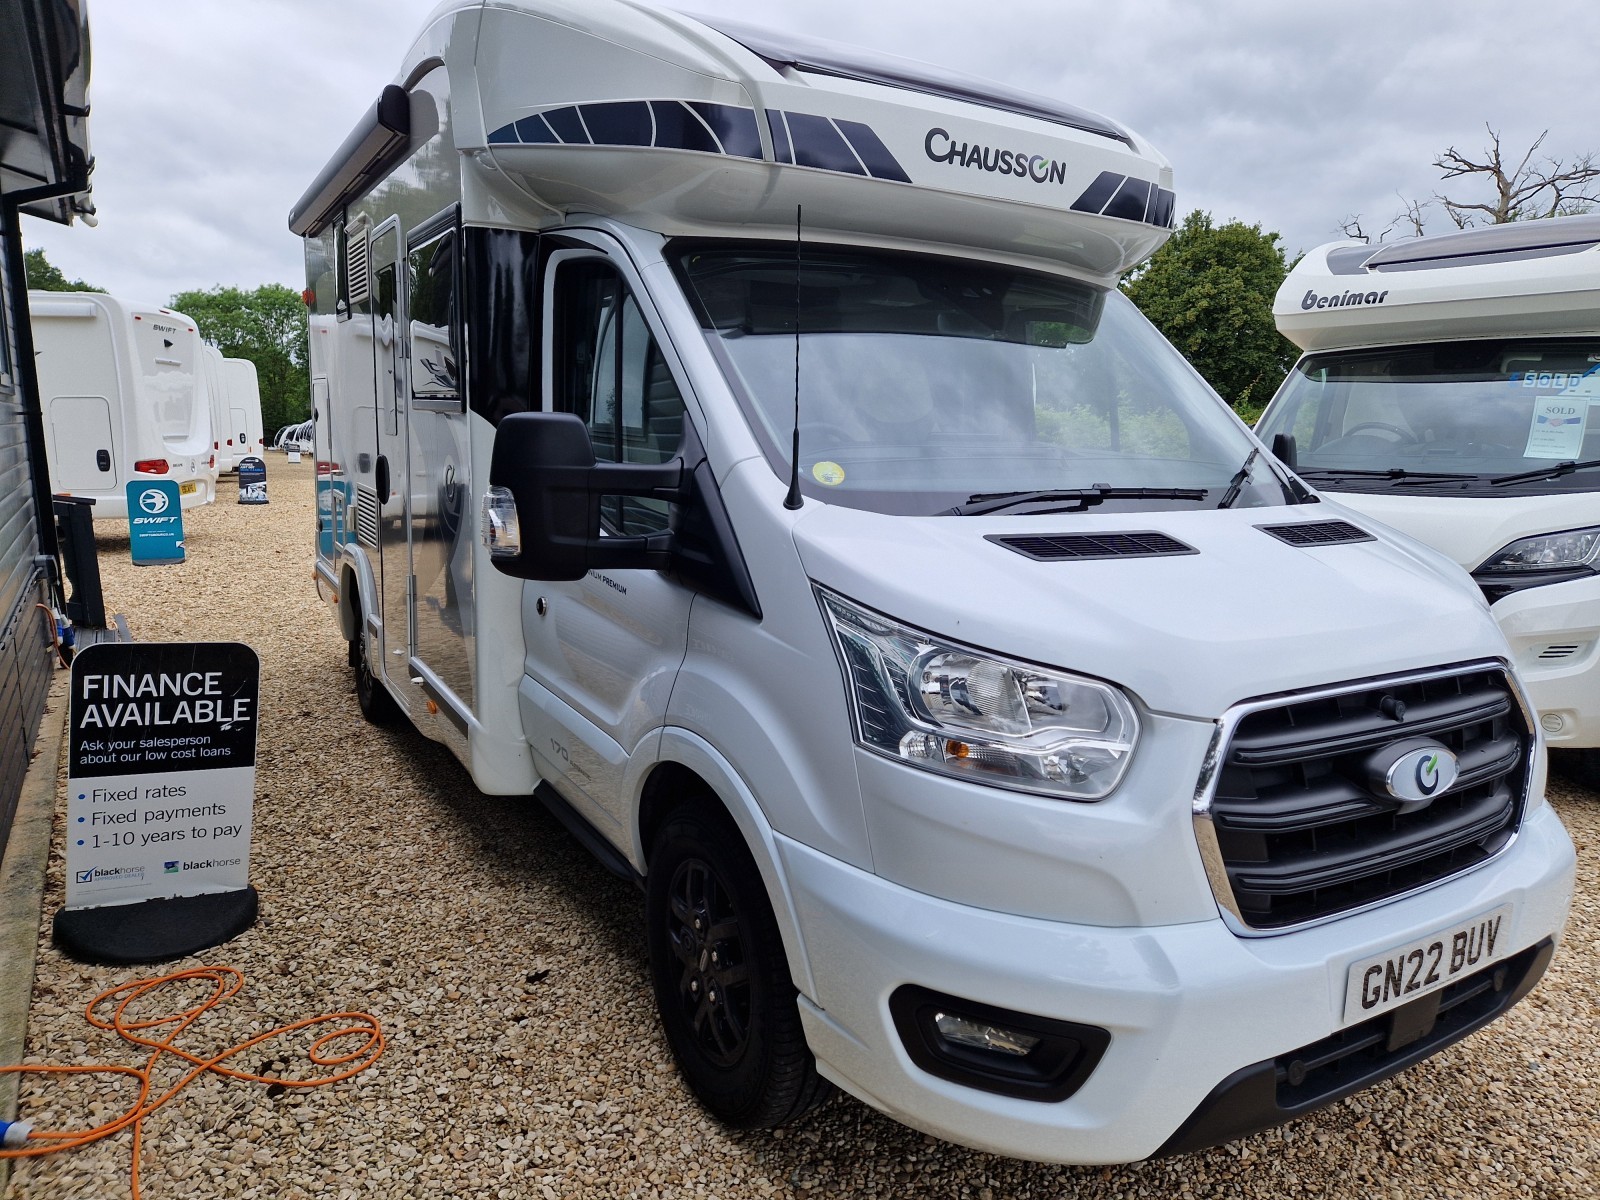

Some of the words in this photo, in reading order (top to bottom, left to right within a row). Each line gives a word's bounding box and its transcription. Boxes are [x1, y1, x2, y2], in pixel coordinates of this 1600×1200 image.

[924, 127, 1067, 185] CHAUSSON
[1301, 289, 1388, 310] benimar
[153, 324, 176, 334] SWIFT
[1525, 375, 1580, 387] SOLD
[1545, 406, 1576, 415] SOLD
[132, 516, 179, 524] SWIFT
[602, 575, 627, 596] PREMIUM
[83, 671, 223, 700] FINANCE
[79, 698, 251, 729] AVAILABLE
[80, 740, 104, 751] Ask
[108, 740, 136, 751] your
[139, 736, 211, 748] salesperson
[550, 737, 569, 762] 170
[80, 752, 117, 764] about
[120, 752, 141, 761] our
[145, 750, 168, 760] low
[171, 748, 197, 759] cost
[200, 747, 231, 757] loans
[92, 786, 138, 803] Fixed
[145, 785, 187, 799] rates
[91, 809, 137, 826] Fixed
[144, 803, 226, 824] payments
[92, 831, 135, 848] 1-10
[140, 829, 186, 846] years
[191, 826, 207, 839] to
[213, 824, 243, 839] pay
[94, 866, 145, 877] blackhorse
[183, 857, 241, 871] blackhorse
[1361, 941, 1444, 1010] GN22
[1449, 915, 1502, 976] BUV
